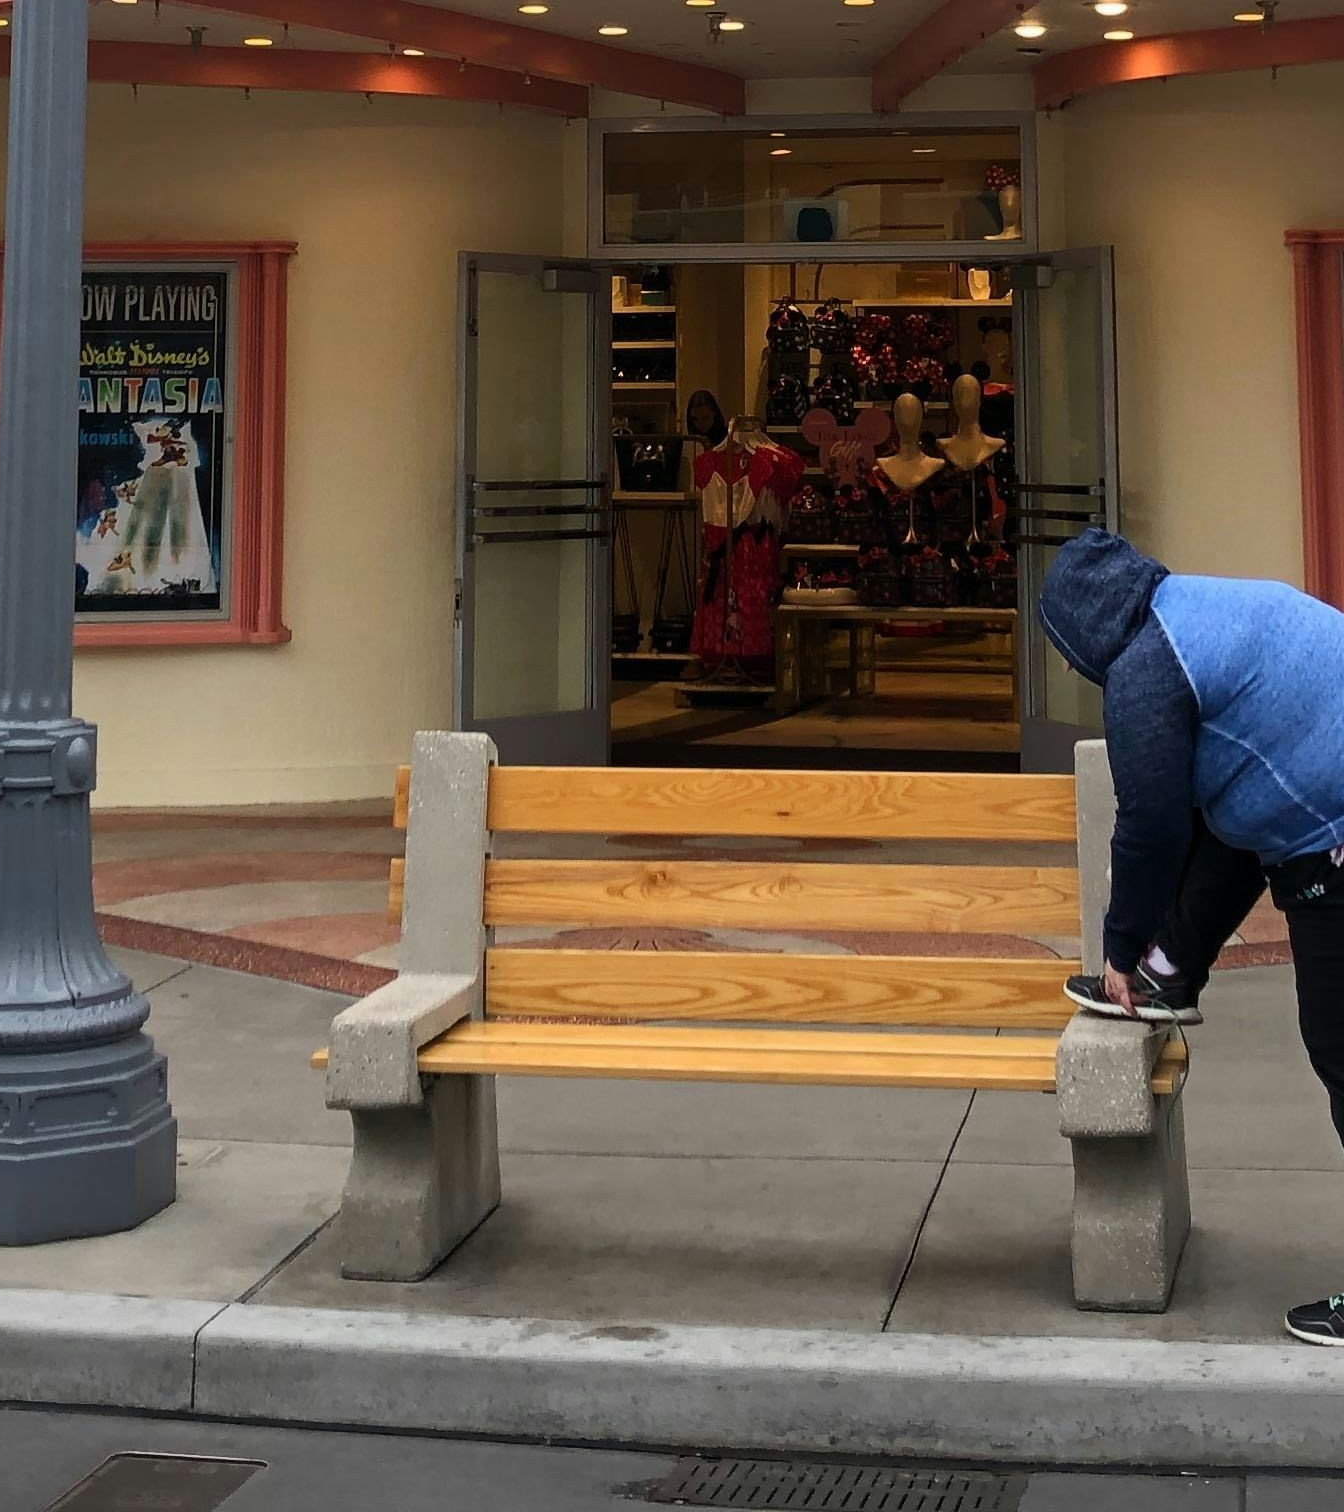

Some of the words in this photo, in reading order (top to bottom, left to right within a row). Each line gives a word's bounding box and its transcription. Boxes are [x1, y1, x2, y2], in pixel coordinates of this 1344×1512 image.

[81, 285, 116, 321] OW
[124, 285, 217, 321] PLAYING
[80, 341, 126, 366] Walt
[129, 340, 209, 368] Disney's
[78, 377, 223, 413] ANTASIA
[79, 428, 134, 446] kowski
